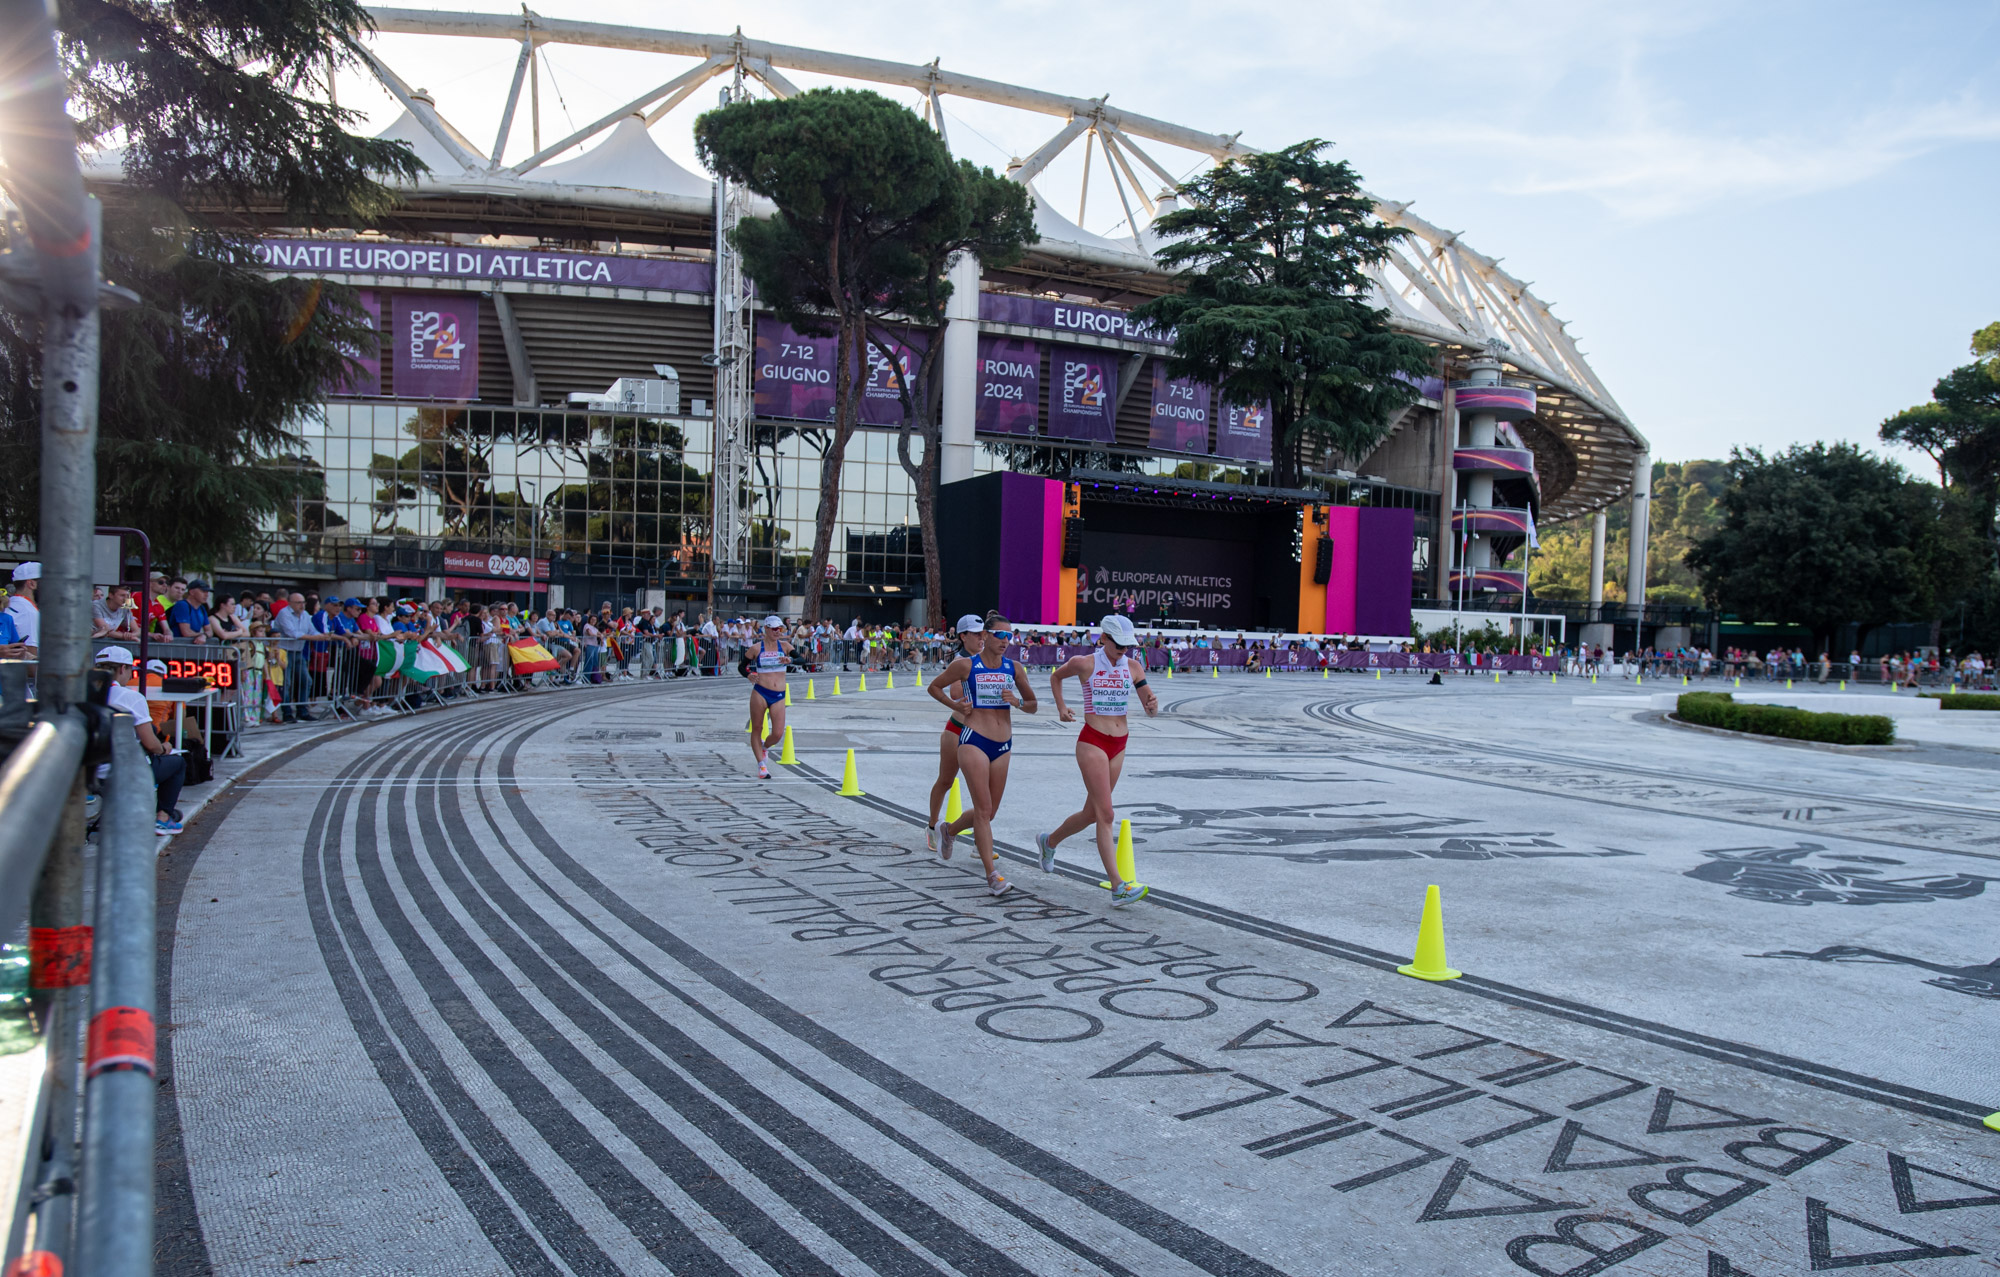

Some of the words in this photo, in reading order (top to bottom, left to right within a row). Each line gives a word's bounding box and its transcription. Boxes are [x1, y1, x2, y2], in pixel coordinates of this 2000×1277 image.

[339, 247, 450, 274] EUROPEI
[456, 251, 482, 276] DI
[488, 254, 613, 283] ATLETICA
[411, 311, 424, 358] roma
[781, 344, 814, 360] 7-12
[761, 364, 831, 383] GIUGNO
[984, 383, 1024, 400] 2024
[1063, 361, 1076, 404] roma
[1170, 384, 1194, 400] 7-12
[1155, 402, 1205, 421] GIUGNO
[444, 557, 464, 567] Distinti
[464, 559, 475, 567] Sud
[475, 559, 485, 568] Est
[490, 558, 501, 571] 22
[504, 559, 515, 572] 23
[518, 561, 529, 573] 24
[1111, 570, 1172, 585] EUROPEAN
[1175, 575, 1232, 589] ATHLETICS
[1093, 587, 1232, 609] CHAMPIONSHIPS
[1092, 689, 1129, 697] CHOJECKA
[1094, 679, 1123, 688] SPAR
[694, 867, 894, 942] BALILLA
[787, 862, 997, 931] BALILLA
[946, 926, 1219, 1021] OPERA
[1051, 916, 1319, 1003] OPERA
[829, 936, 1105, 1043] OPERA
[1325, 1000, 1853, 1178] BALILLA
[1220, 1018, 1771, 1228] BALILLA
[1090, 1041, 1672, 1277] BALILLA
